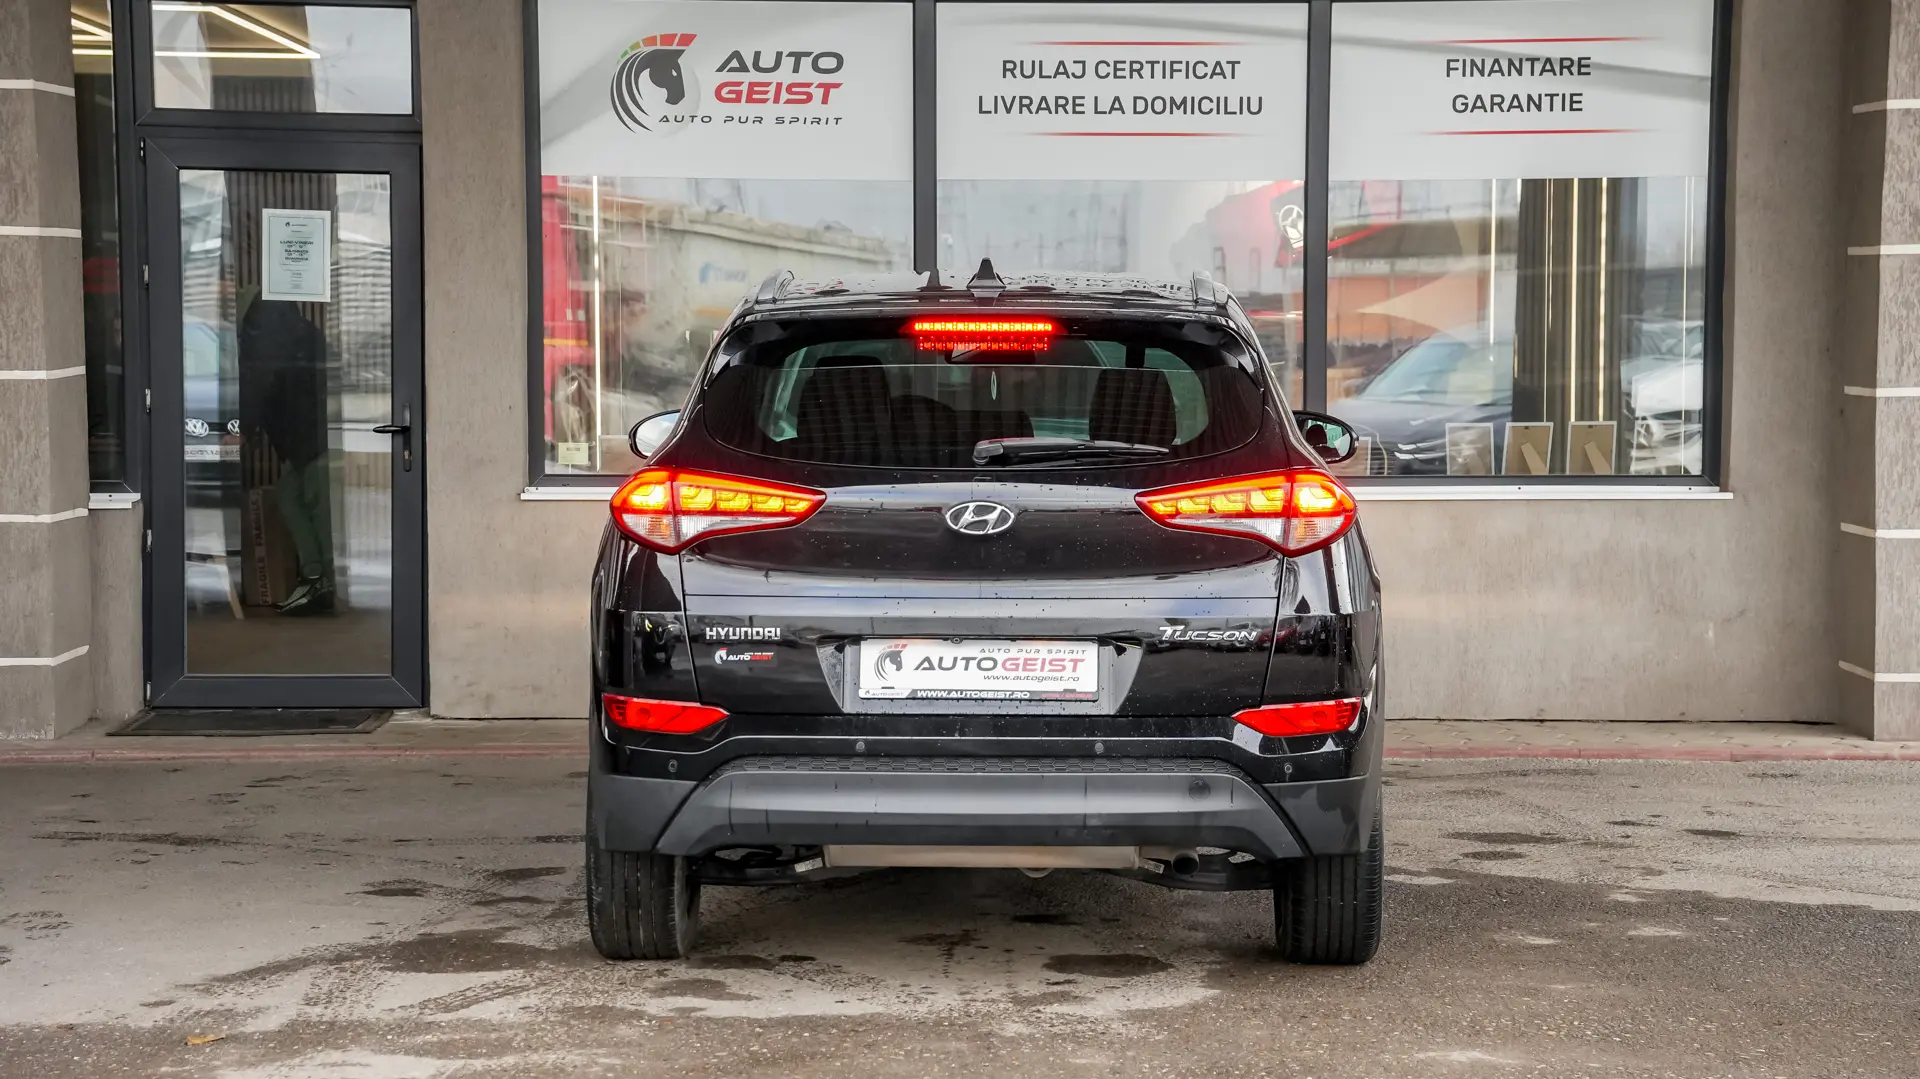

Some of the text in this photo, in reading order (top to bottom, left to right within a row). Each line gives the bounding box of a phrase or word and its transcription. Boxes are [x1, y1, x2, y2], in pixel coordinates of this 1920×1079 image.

[714, 49, 845, 75] AUTO
[1001, 59, 1242, 80] RULAJ CERTIFICAT
[1445, 56, 1592, 78] FINANTARE
[714, 81, 844, 105] GEIST
[977, 95, 1263, 116] LIVRARE LA DOMICILIU
[1451, 92, 1584, 114] GARANTIE
[658, 114, 843, 126] AUTO PUR SPIRIT
[705, 627, 781, 640] HYUNDAI
[1158, 625, 1258, 641] TUCSON
[913, 655, 1086, 673] AUTOGEIST
[983, 674, 1080, 683] www.autogeist.ro
[916, 689, 1030, 699] WWW.AUTOGEIST.RO
